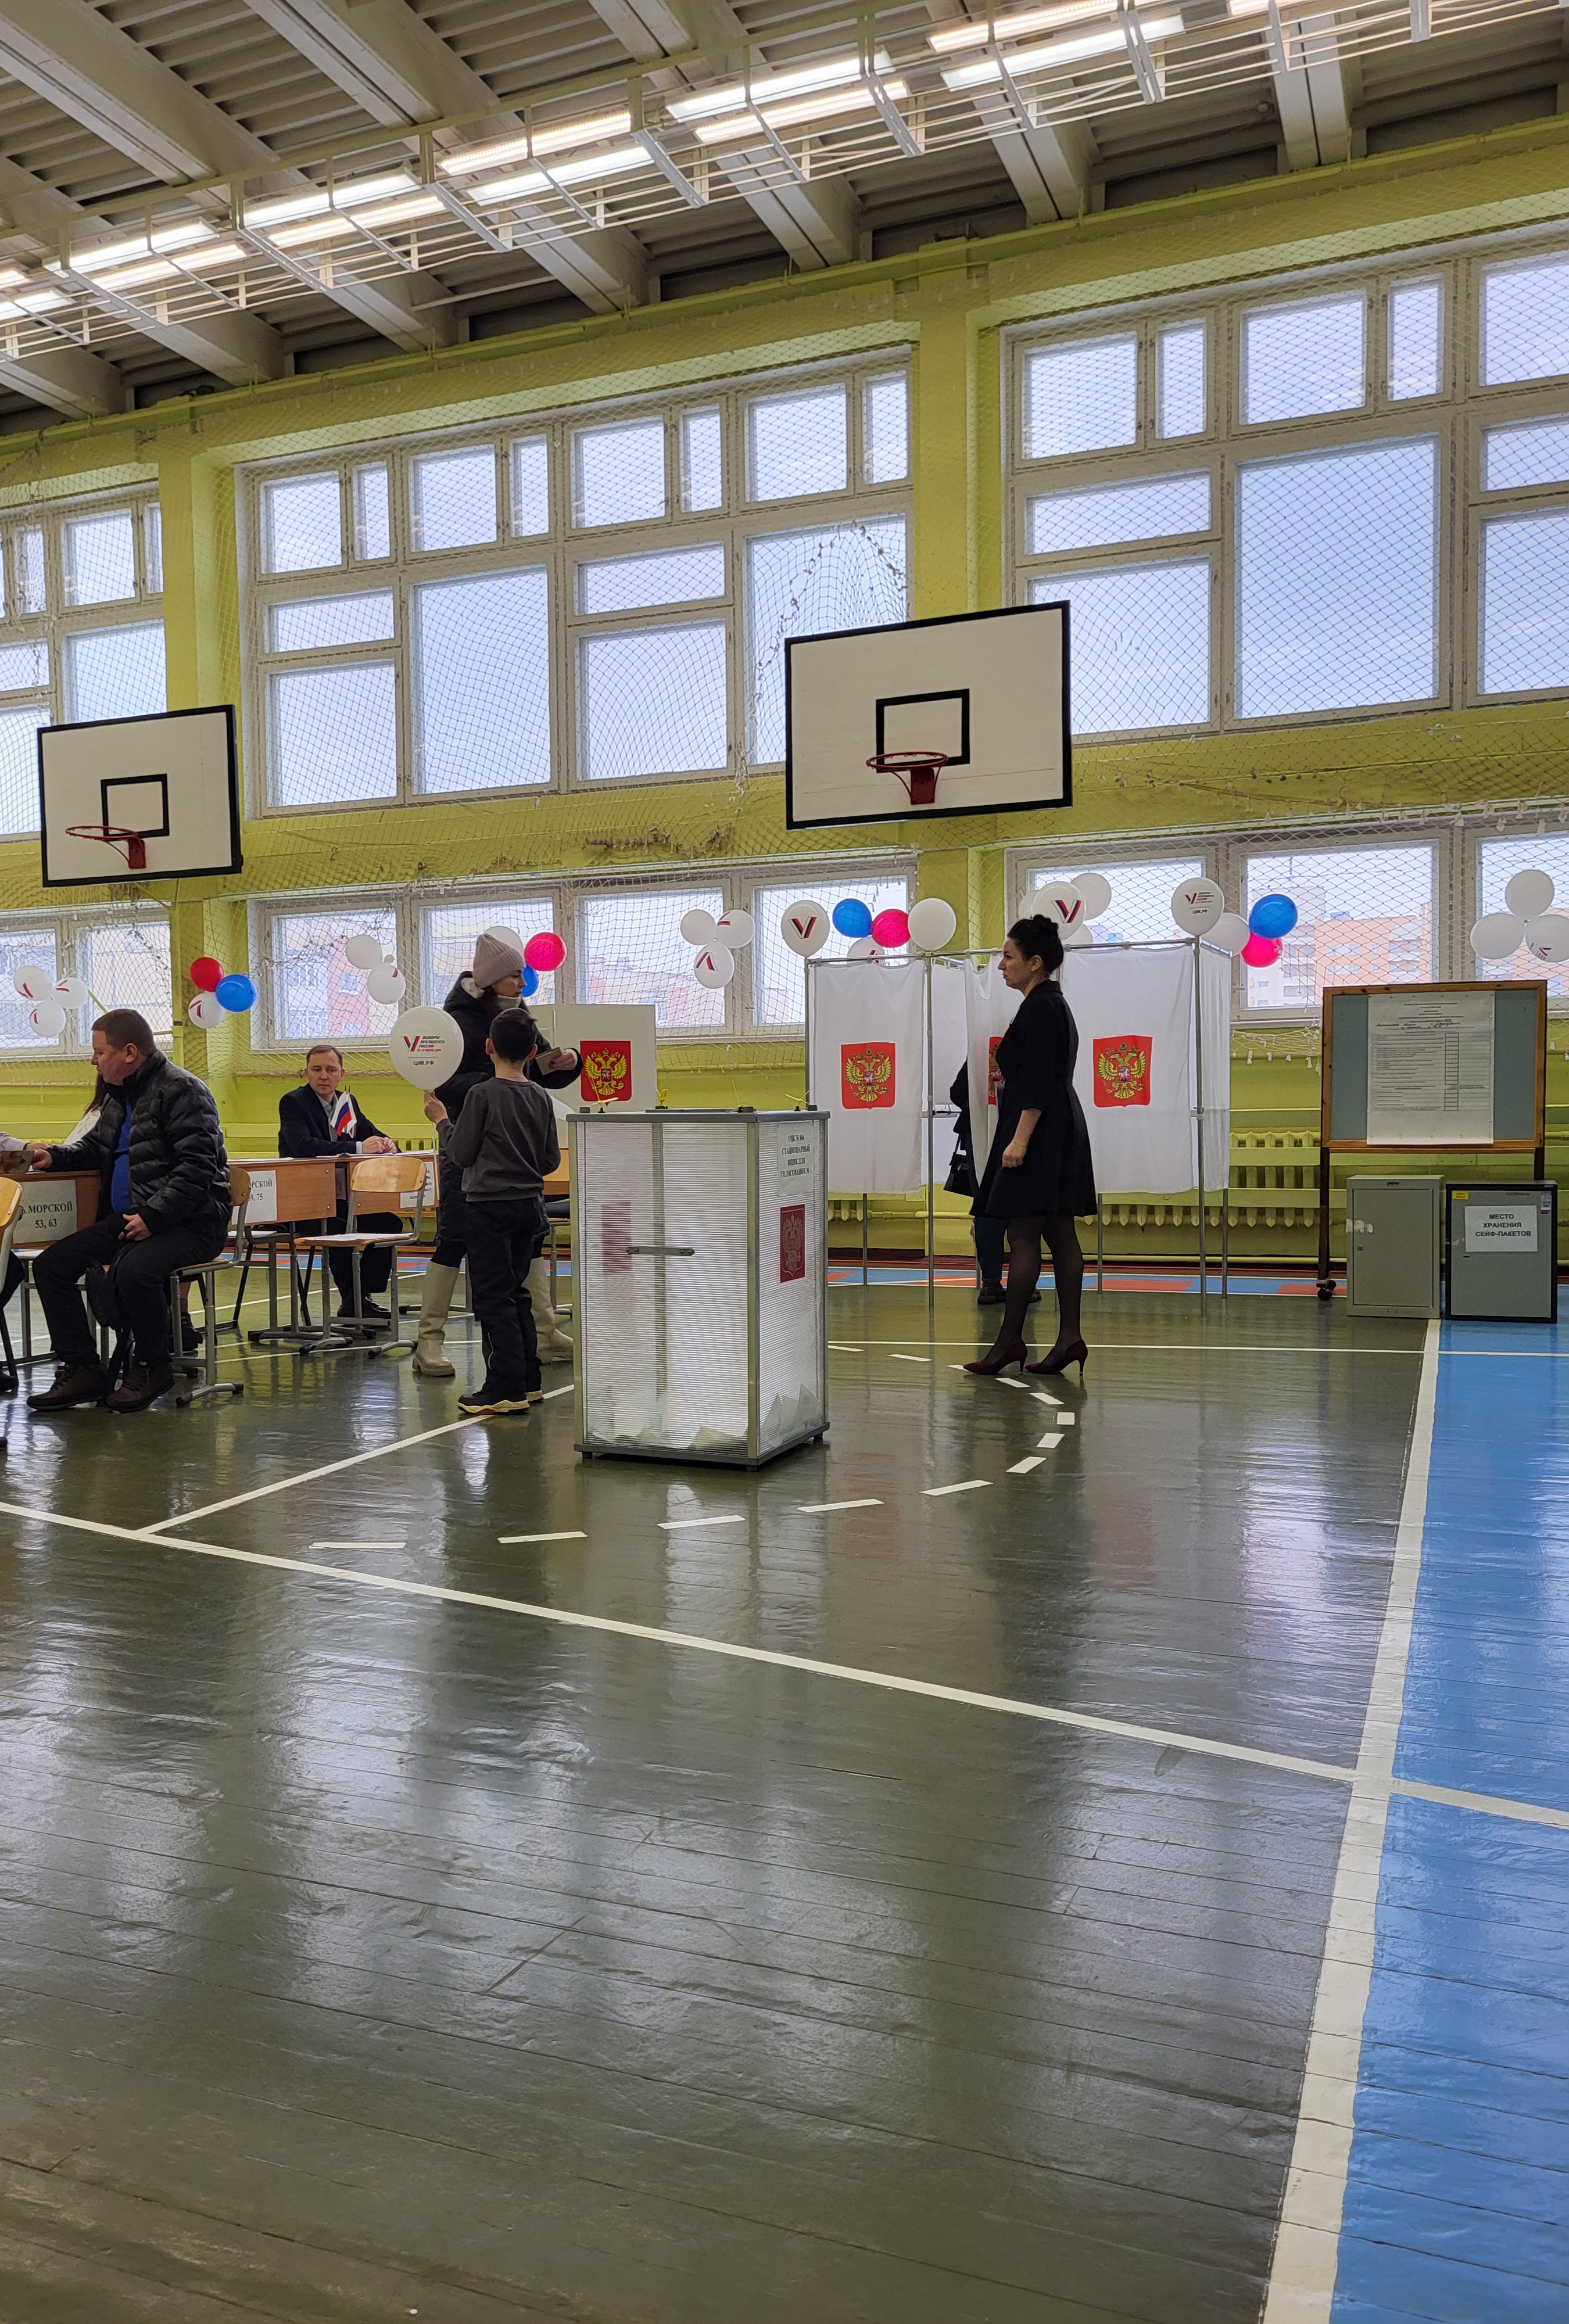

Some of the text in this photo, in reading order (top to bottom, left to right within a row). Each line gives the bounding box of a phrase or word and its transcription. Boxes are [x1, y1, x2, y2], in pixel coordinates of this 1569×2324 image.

[250, 1178, 273, 1189] РСКОЙ
[256, 1193, 263, 1201] 75
[28, 1200, 73, 1214] МОРСКОЙ
[35, 1218, 57, 1229] 53, 63
